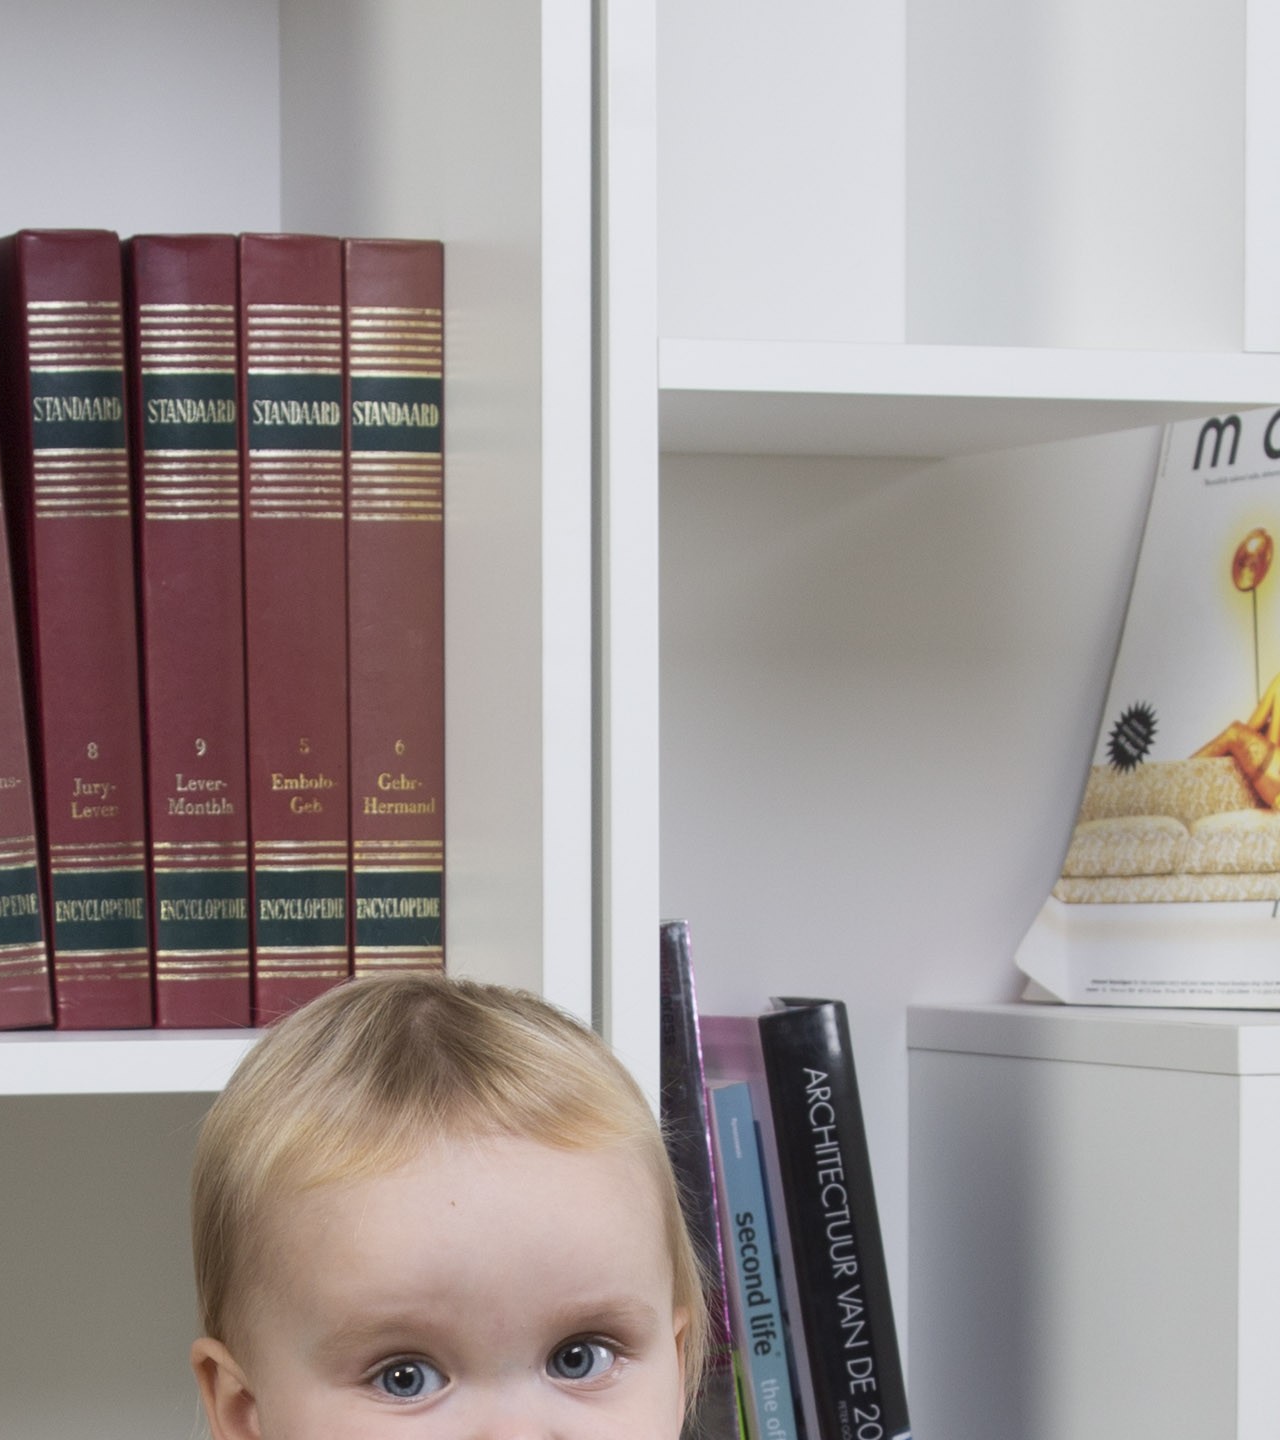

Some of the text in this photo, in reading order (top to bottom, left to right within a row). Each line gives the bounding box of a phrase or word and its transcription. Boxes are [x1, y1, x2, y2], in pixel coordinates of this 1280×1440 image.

[33, 396, 122, 423] STANDAARD
[147, 398, 237, 424] STANDAARD
[252, 399, 341, 426] STANDAARD
[352, 400, 439, 428] STANDAARD
[87, 742, 99, 759] 8
[195, 738, 207, 757] 9
[299, 738, 311, 755] 5
[394, 739, 406, 756] 6
[55, 897, 144, 923] ENCYCLOPEDIE
[160, 898, 247, 921] ENCYCLOPEDIE
[259, 898, 345, 921] ENCYCLOPEDIE
[356, 897, 440, 921] ENCYCLOPEDIE
[803, 1067, 858, 1279] ARCHITECTUUR
[736, 1210, 776, 1356] second life
[837, 1285, 870, 1349] VAN
[847, 1357, 877, 1395] DE
[760, 1377, 779, 1413] the
